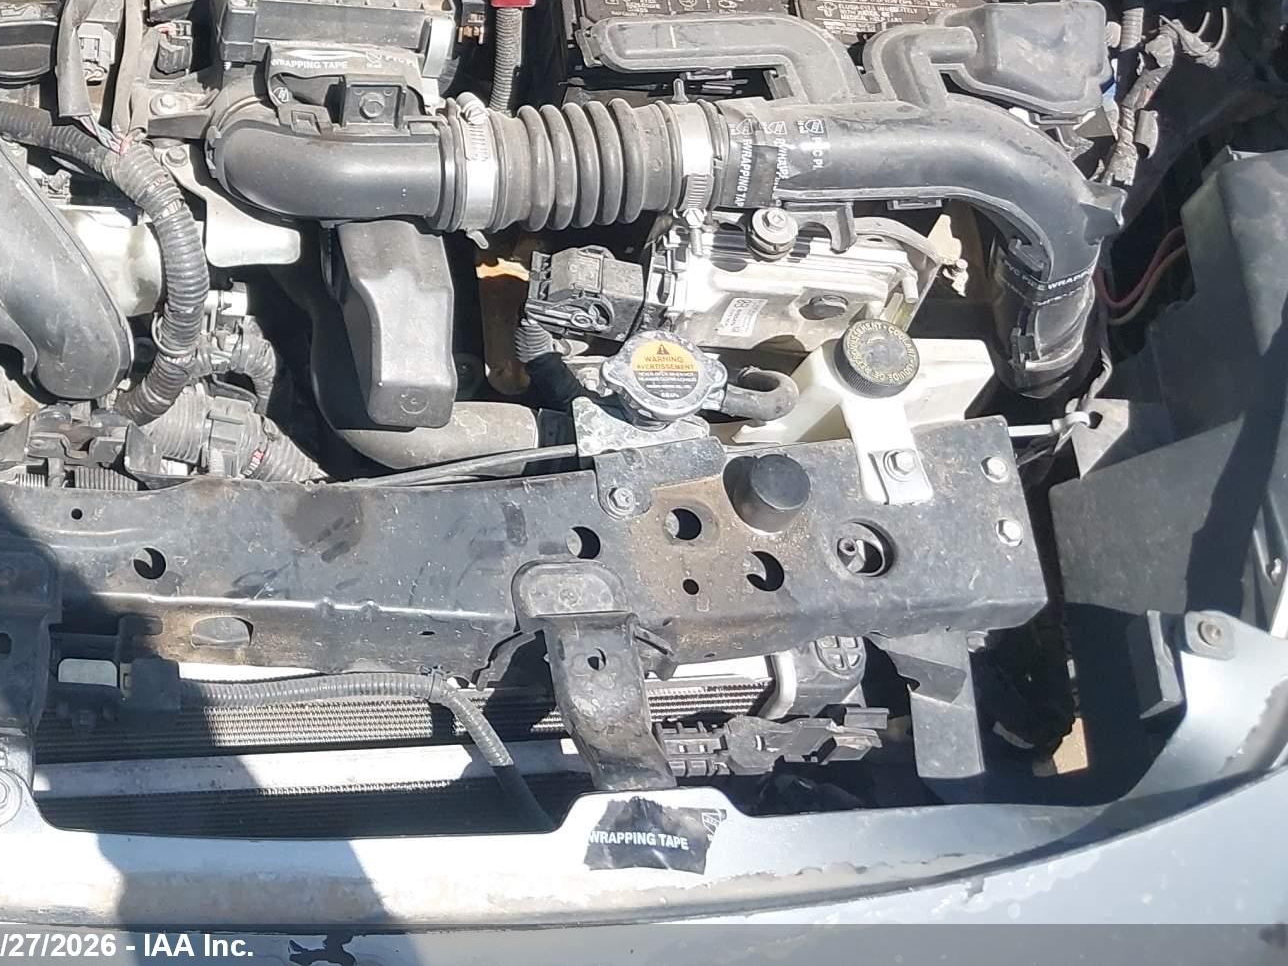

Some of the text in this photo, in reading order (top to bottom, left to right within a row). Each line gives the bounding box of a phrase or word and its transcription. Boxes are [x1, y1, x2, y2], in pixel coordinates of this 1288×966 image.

[271, 58, 349, 69] WRAPPING TAPE
[643, 355, 684, 363] WARNING
[587, 830, 690, 851] WRAPPING TAPE
